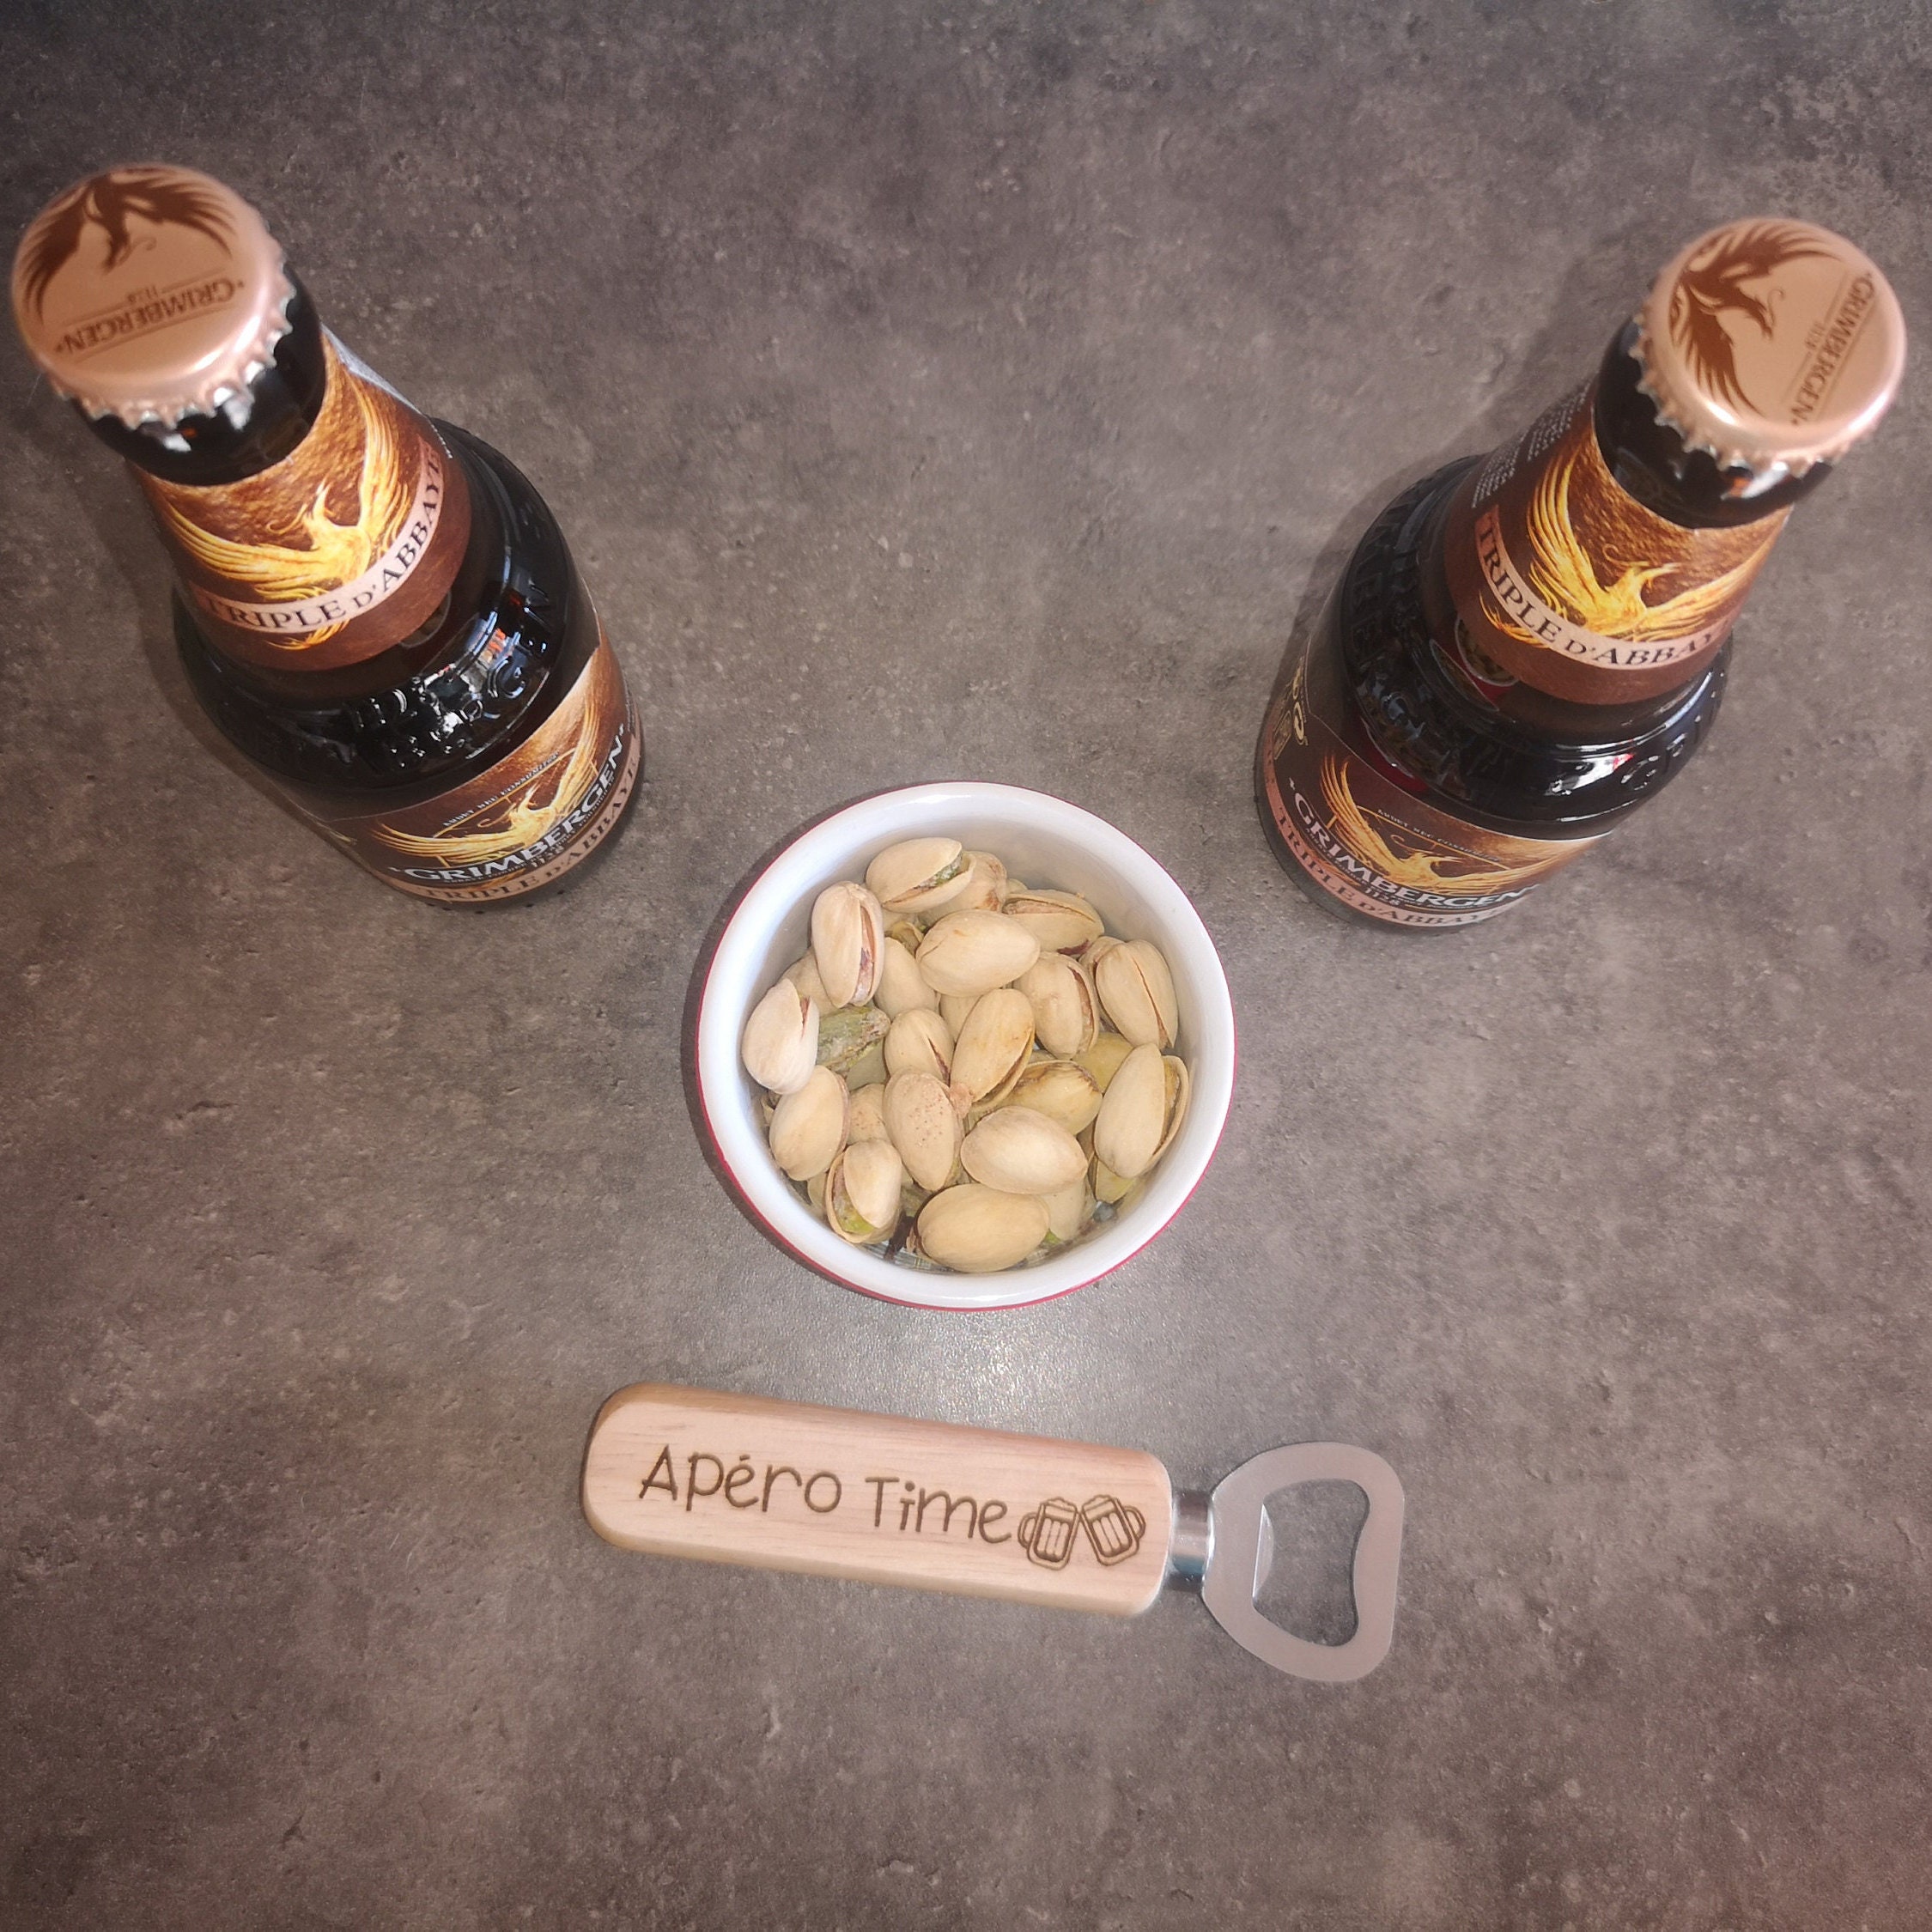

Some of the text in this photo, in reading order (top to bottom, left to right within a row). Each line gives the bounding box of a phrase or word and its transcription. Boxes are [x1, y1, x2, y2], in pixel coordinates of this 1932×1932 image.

[1479, 515, 1564, 643] TRIPLE
[404, 734, 623, 880] GRIMBERGEN
[1294, 792, 1530, 907] GRIMBERGEN
[638, 1444, 1013, 1545] Apéro Time
